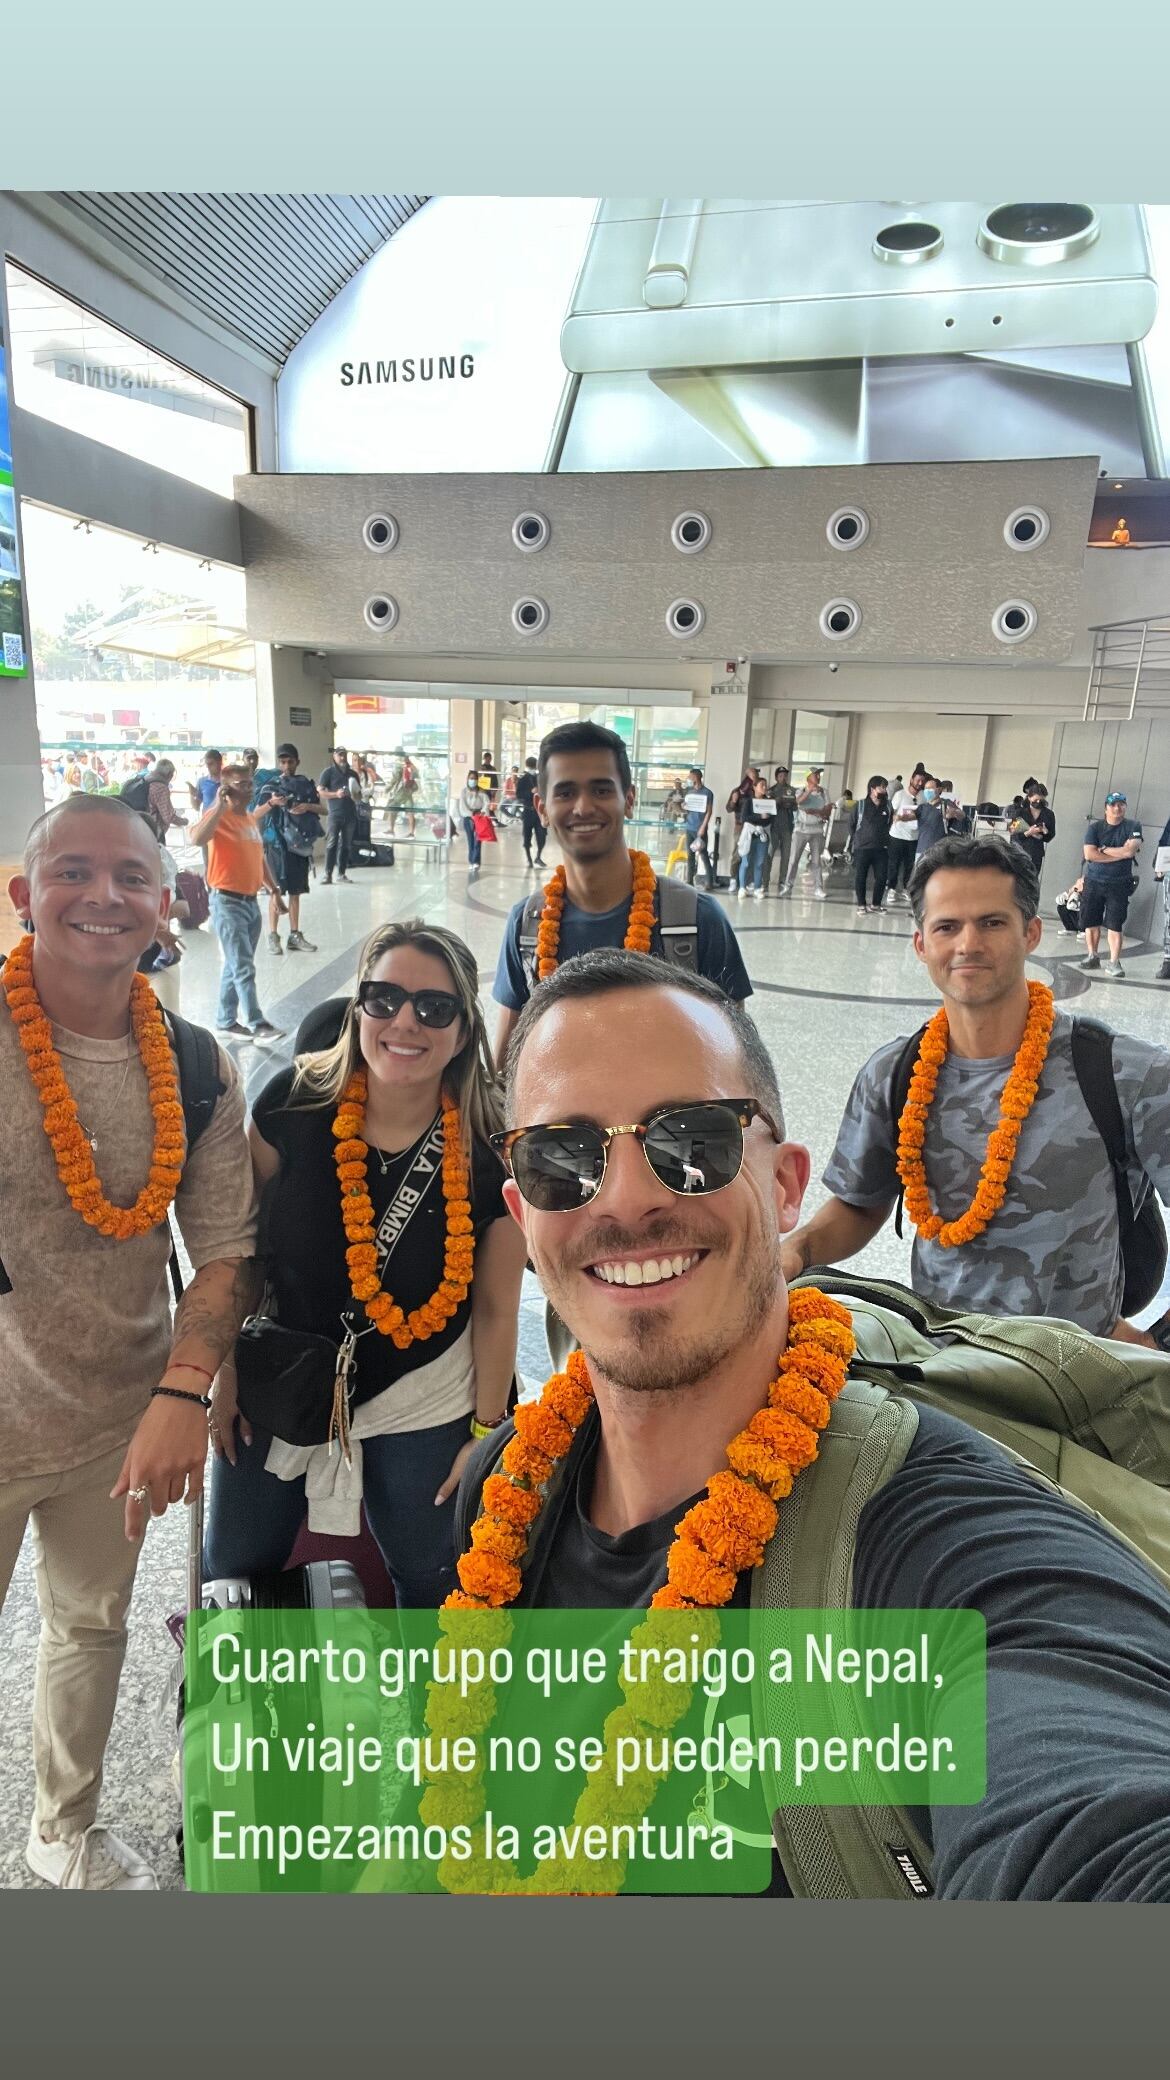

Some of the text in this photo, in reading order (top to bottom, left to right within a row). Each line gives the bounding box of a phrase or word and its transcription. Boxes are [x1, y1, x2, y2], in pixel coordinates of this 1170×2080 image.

[340, 354, 475, 387] SAMSUNG
[375, 1121, 445, 1257] OLA BIMBA
[897, 1855, 928, 1893] THULE
